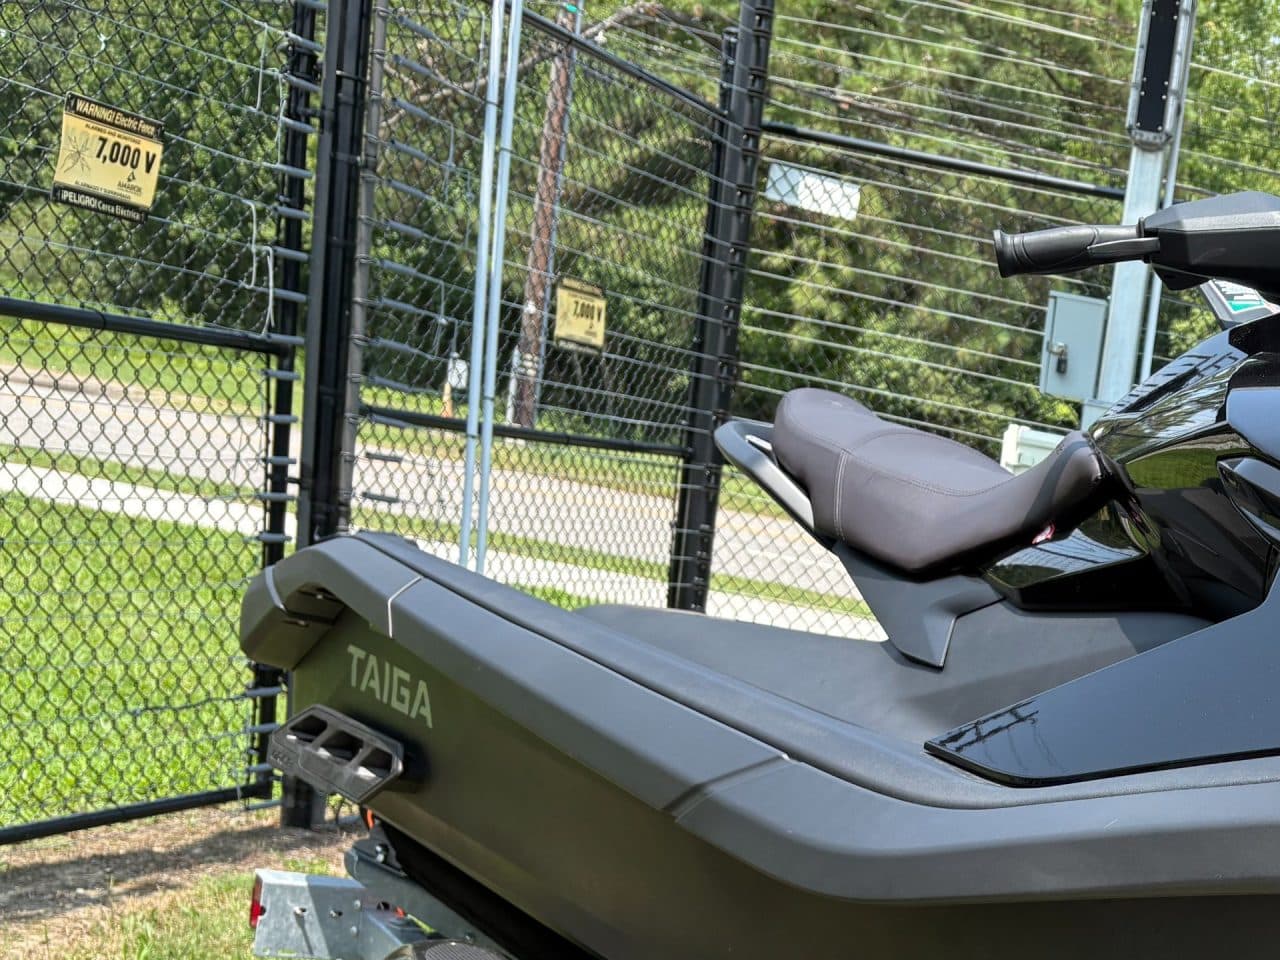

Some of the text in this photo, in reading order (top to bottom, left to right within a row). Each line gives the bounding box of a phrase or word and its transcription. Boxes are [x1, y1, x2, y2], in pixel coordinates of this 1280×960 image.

[76, 98, 155, 136] WARNING! Electric Fence
[96, 137, 157, 174] 7,000 V
[347, 644, 433, 729] TAIGA
